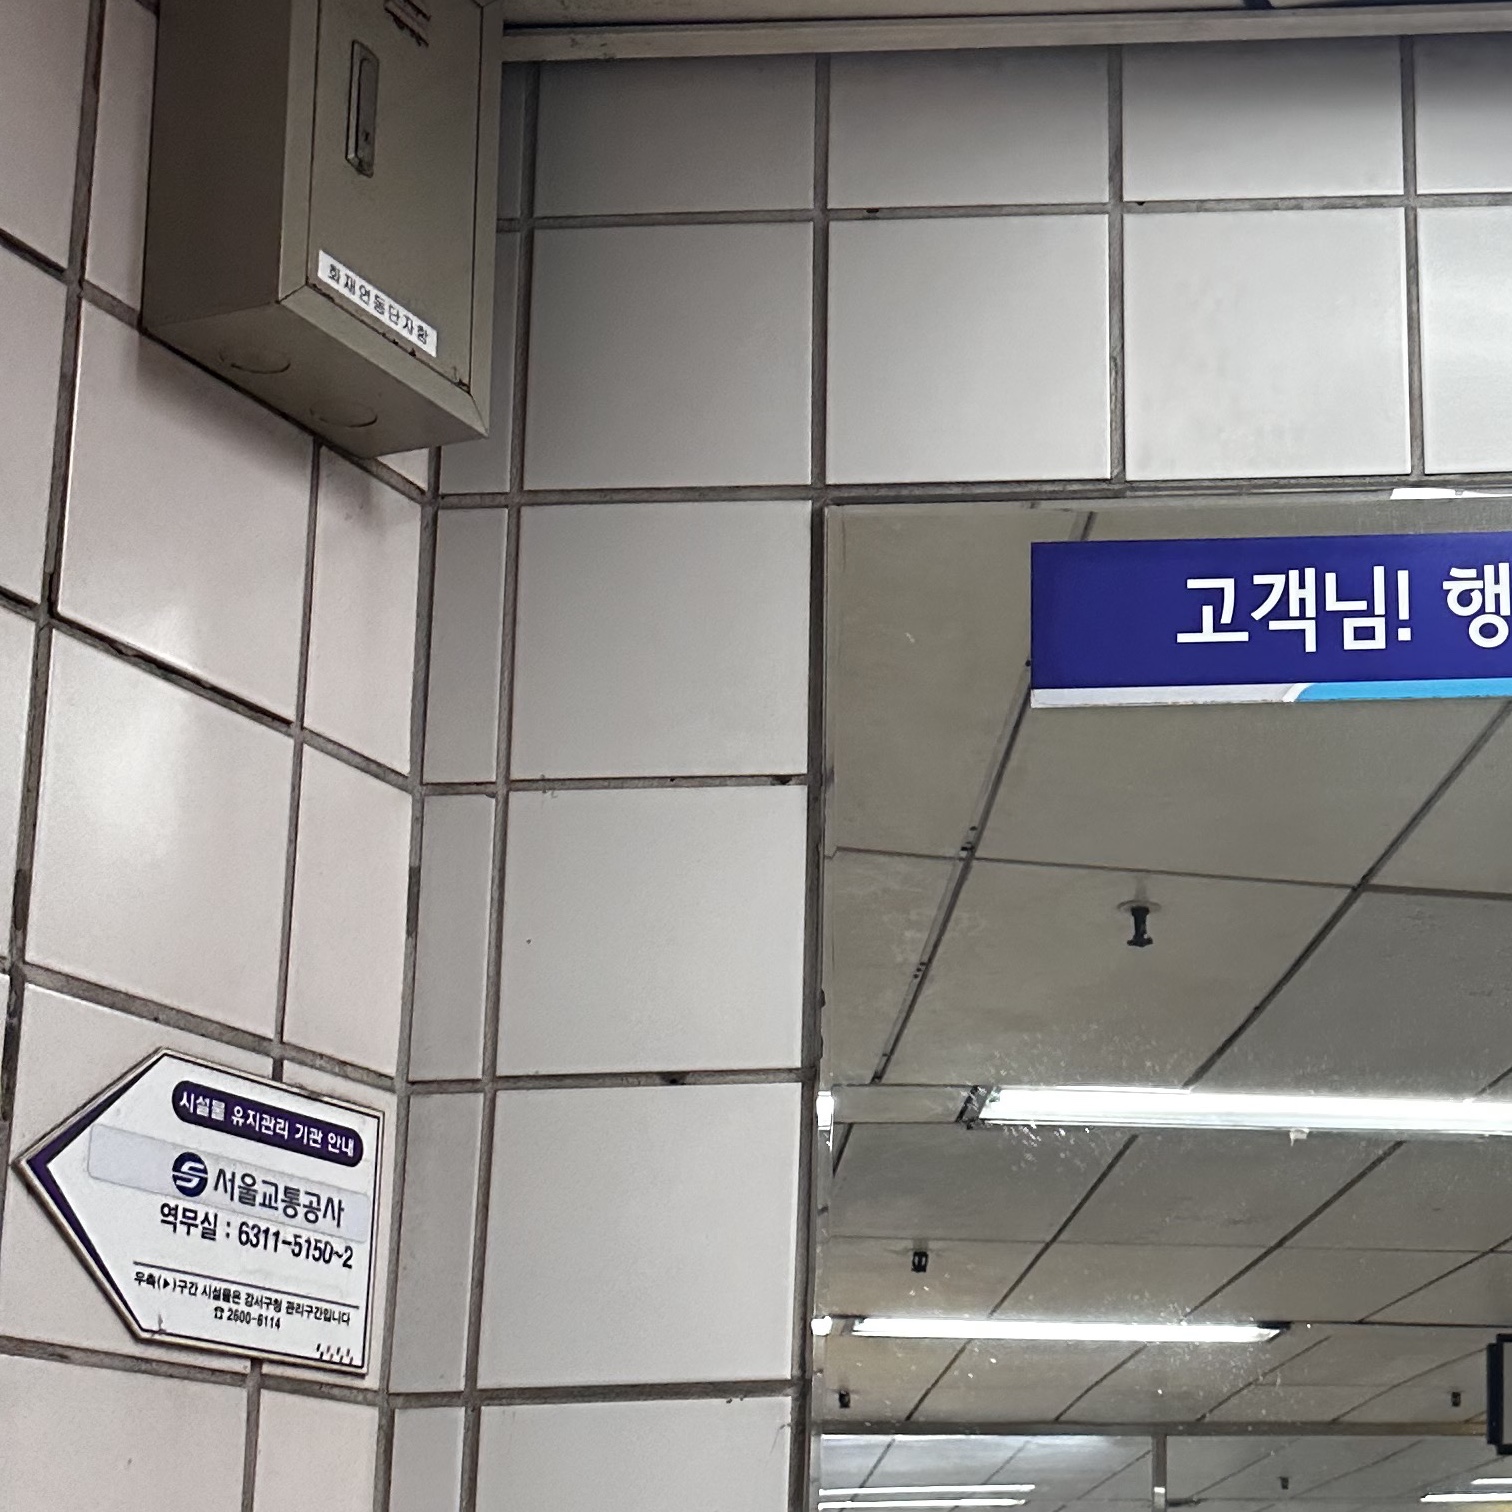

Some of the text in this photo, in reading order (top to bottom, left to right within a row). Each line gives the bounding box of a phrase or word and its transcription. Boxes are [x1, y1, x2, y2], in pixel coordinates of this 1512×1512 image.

[327, 263, 429, 346] 화재연동단자함
[1176, 567, 1412, 654] 고객님!
[179, 1090, 356, 1159] 시설물 유지관리 기관 안내
[213, 1166, 346, 1229] 서울교통공사
[159, 1202, 219, 1242] 역무실
[238, 1220, 354, 1270] 6311-5150~2
[201, 1283, 242, 1306] 시설물은
[244, 1292, 284, 1313] 강서구청
[285, 1300, 351, 1326] 관리구간입니다
